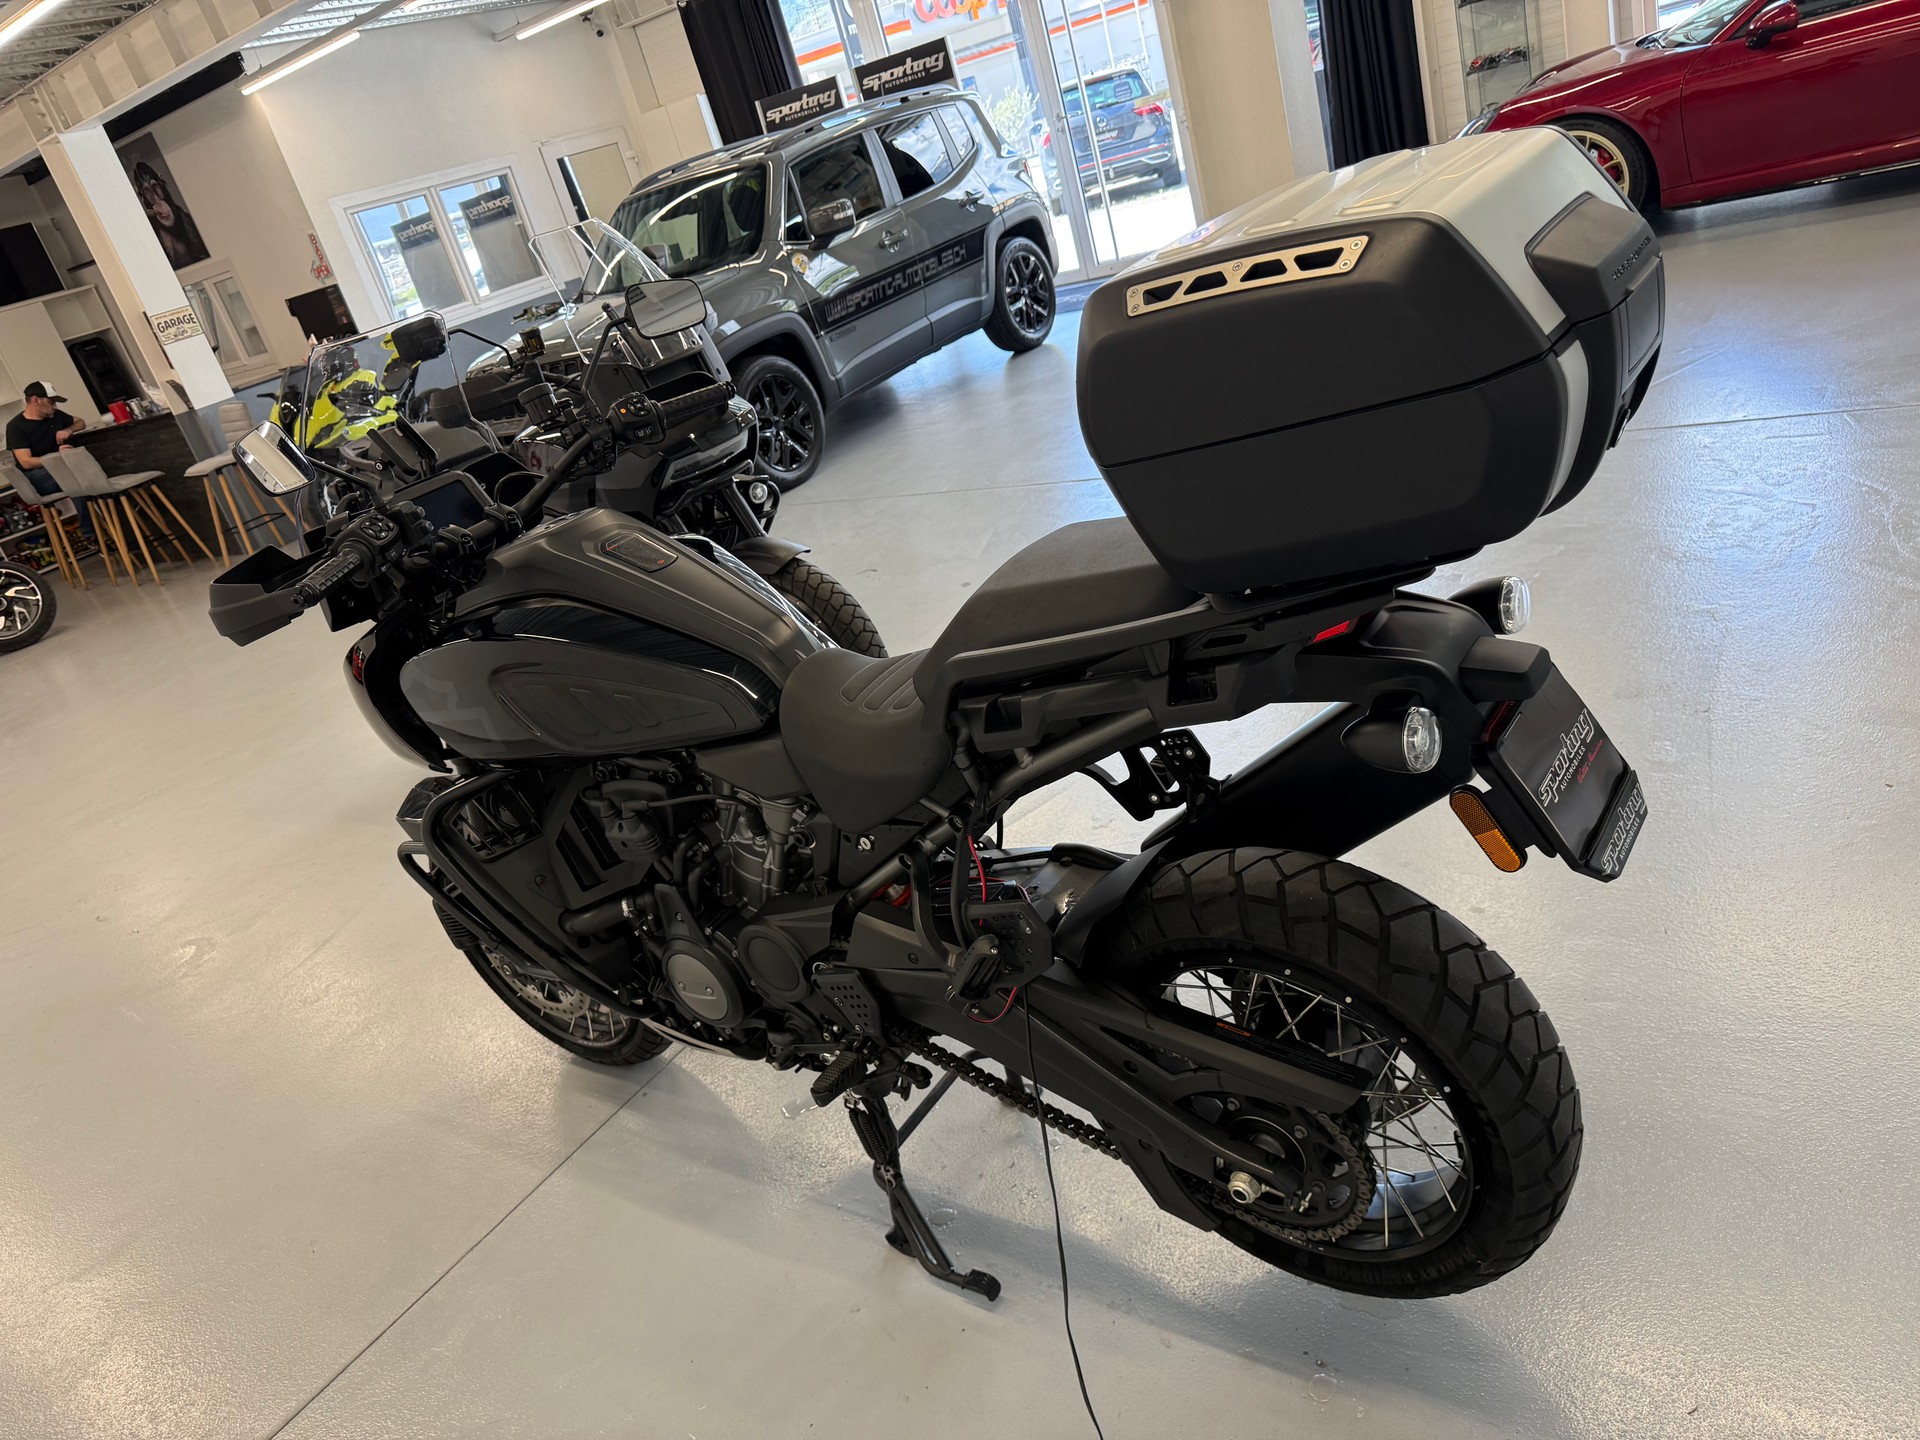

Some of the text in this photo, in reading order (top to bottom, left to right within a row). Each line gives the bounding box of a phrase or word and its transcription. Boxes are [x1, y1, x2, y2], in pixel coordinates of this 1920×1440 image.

[862, 51, 945, 92] sporting
[885, 71, 926, 88] AUTOMOBILES
[766, 89, 836, 124] sporting
[785, 107, 820, 122] AUTOMOBILES
[156, 312, 197, 334] GARAGE
[1539, 709, 1594, 806] sporting
[1560, 745, 1586, 792] AUTOMOBILES
[1602, 783, 1646, 875] sporting
[1619, 818, 1641, 862] AUTOMOBILES
